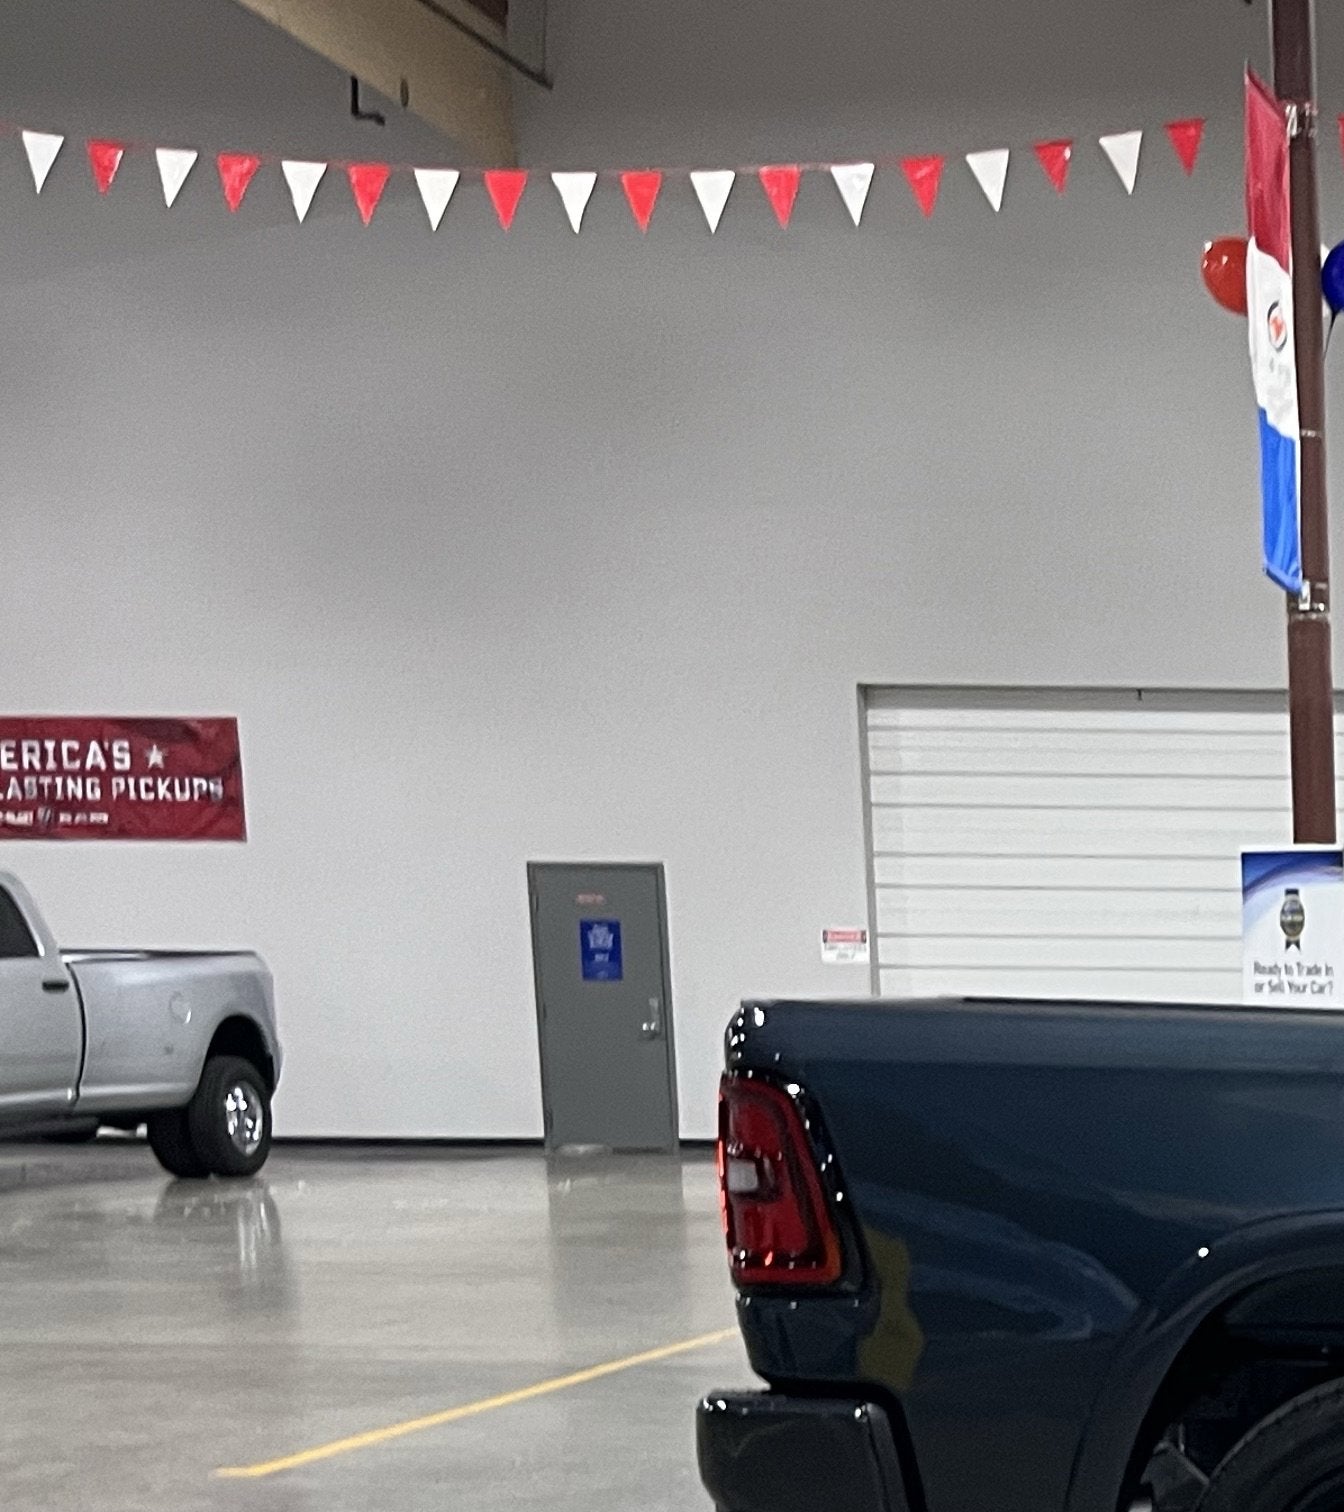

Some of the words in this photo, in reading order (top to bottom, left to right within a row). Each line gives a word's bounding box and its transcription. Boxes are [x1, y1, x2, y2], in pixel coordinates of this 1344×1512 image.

[0, 776, 101, 801] ASTING
[111, 776, 224, 803] PICKUPS
[1253, 960, 1281, 981] Ready
[1284, 962, 1294, 976] to
[1296, 961, 1322, 976] Trade
[1254, 982, 1265, 993] or
[1268, 979, 1285, 993] Sell
[1287, 980, 1307, 993] Your
[1310, 980, 1333, 995] Car?
